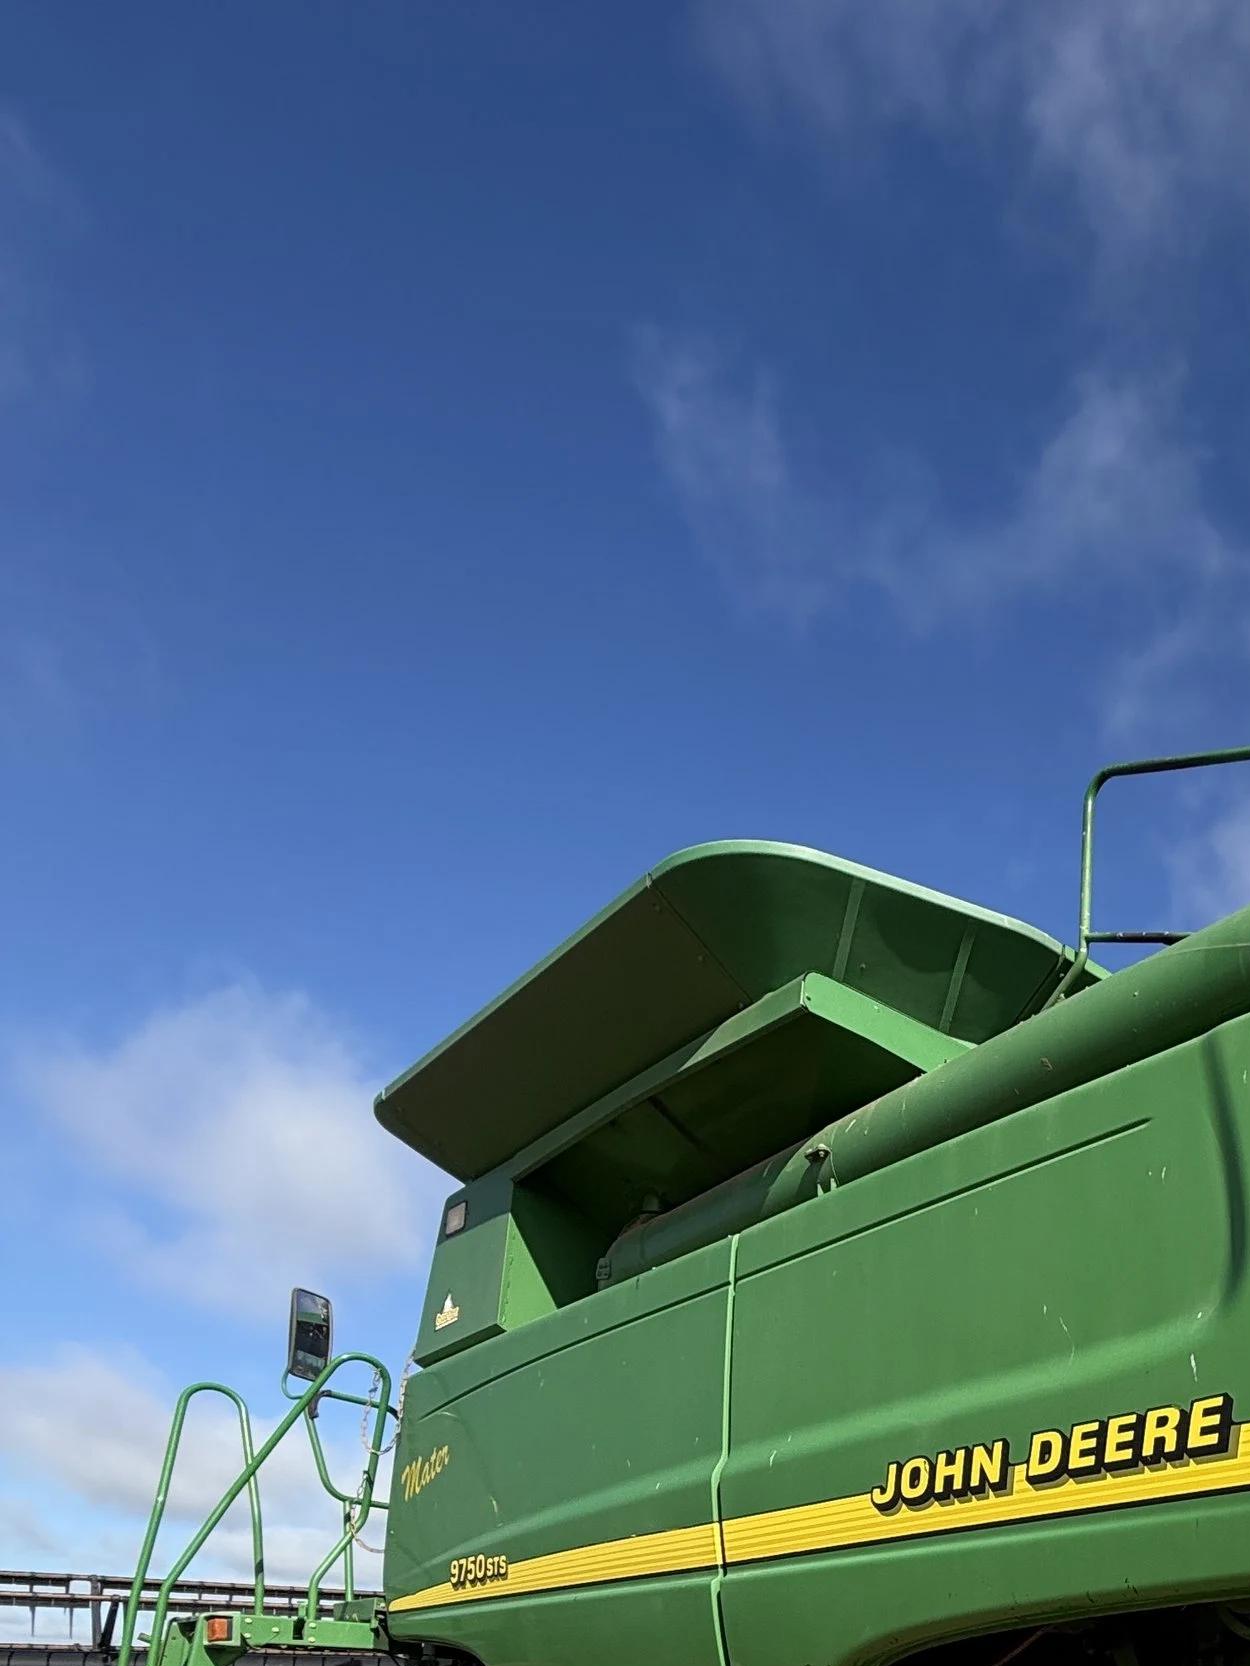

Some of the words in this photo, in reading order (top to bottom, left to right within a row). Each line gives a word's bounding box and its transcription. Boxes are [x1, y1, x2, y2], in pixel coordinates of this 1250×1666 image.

[401, 1445, 450, 1502] Mater
[871, 1440, 1004, 1506] JOHN
[1027, 1395, 1226, 1478] DEERE
